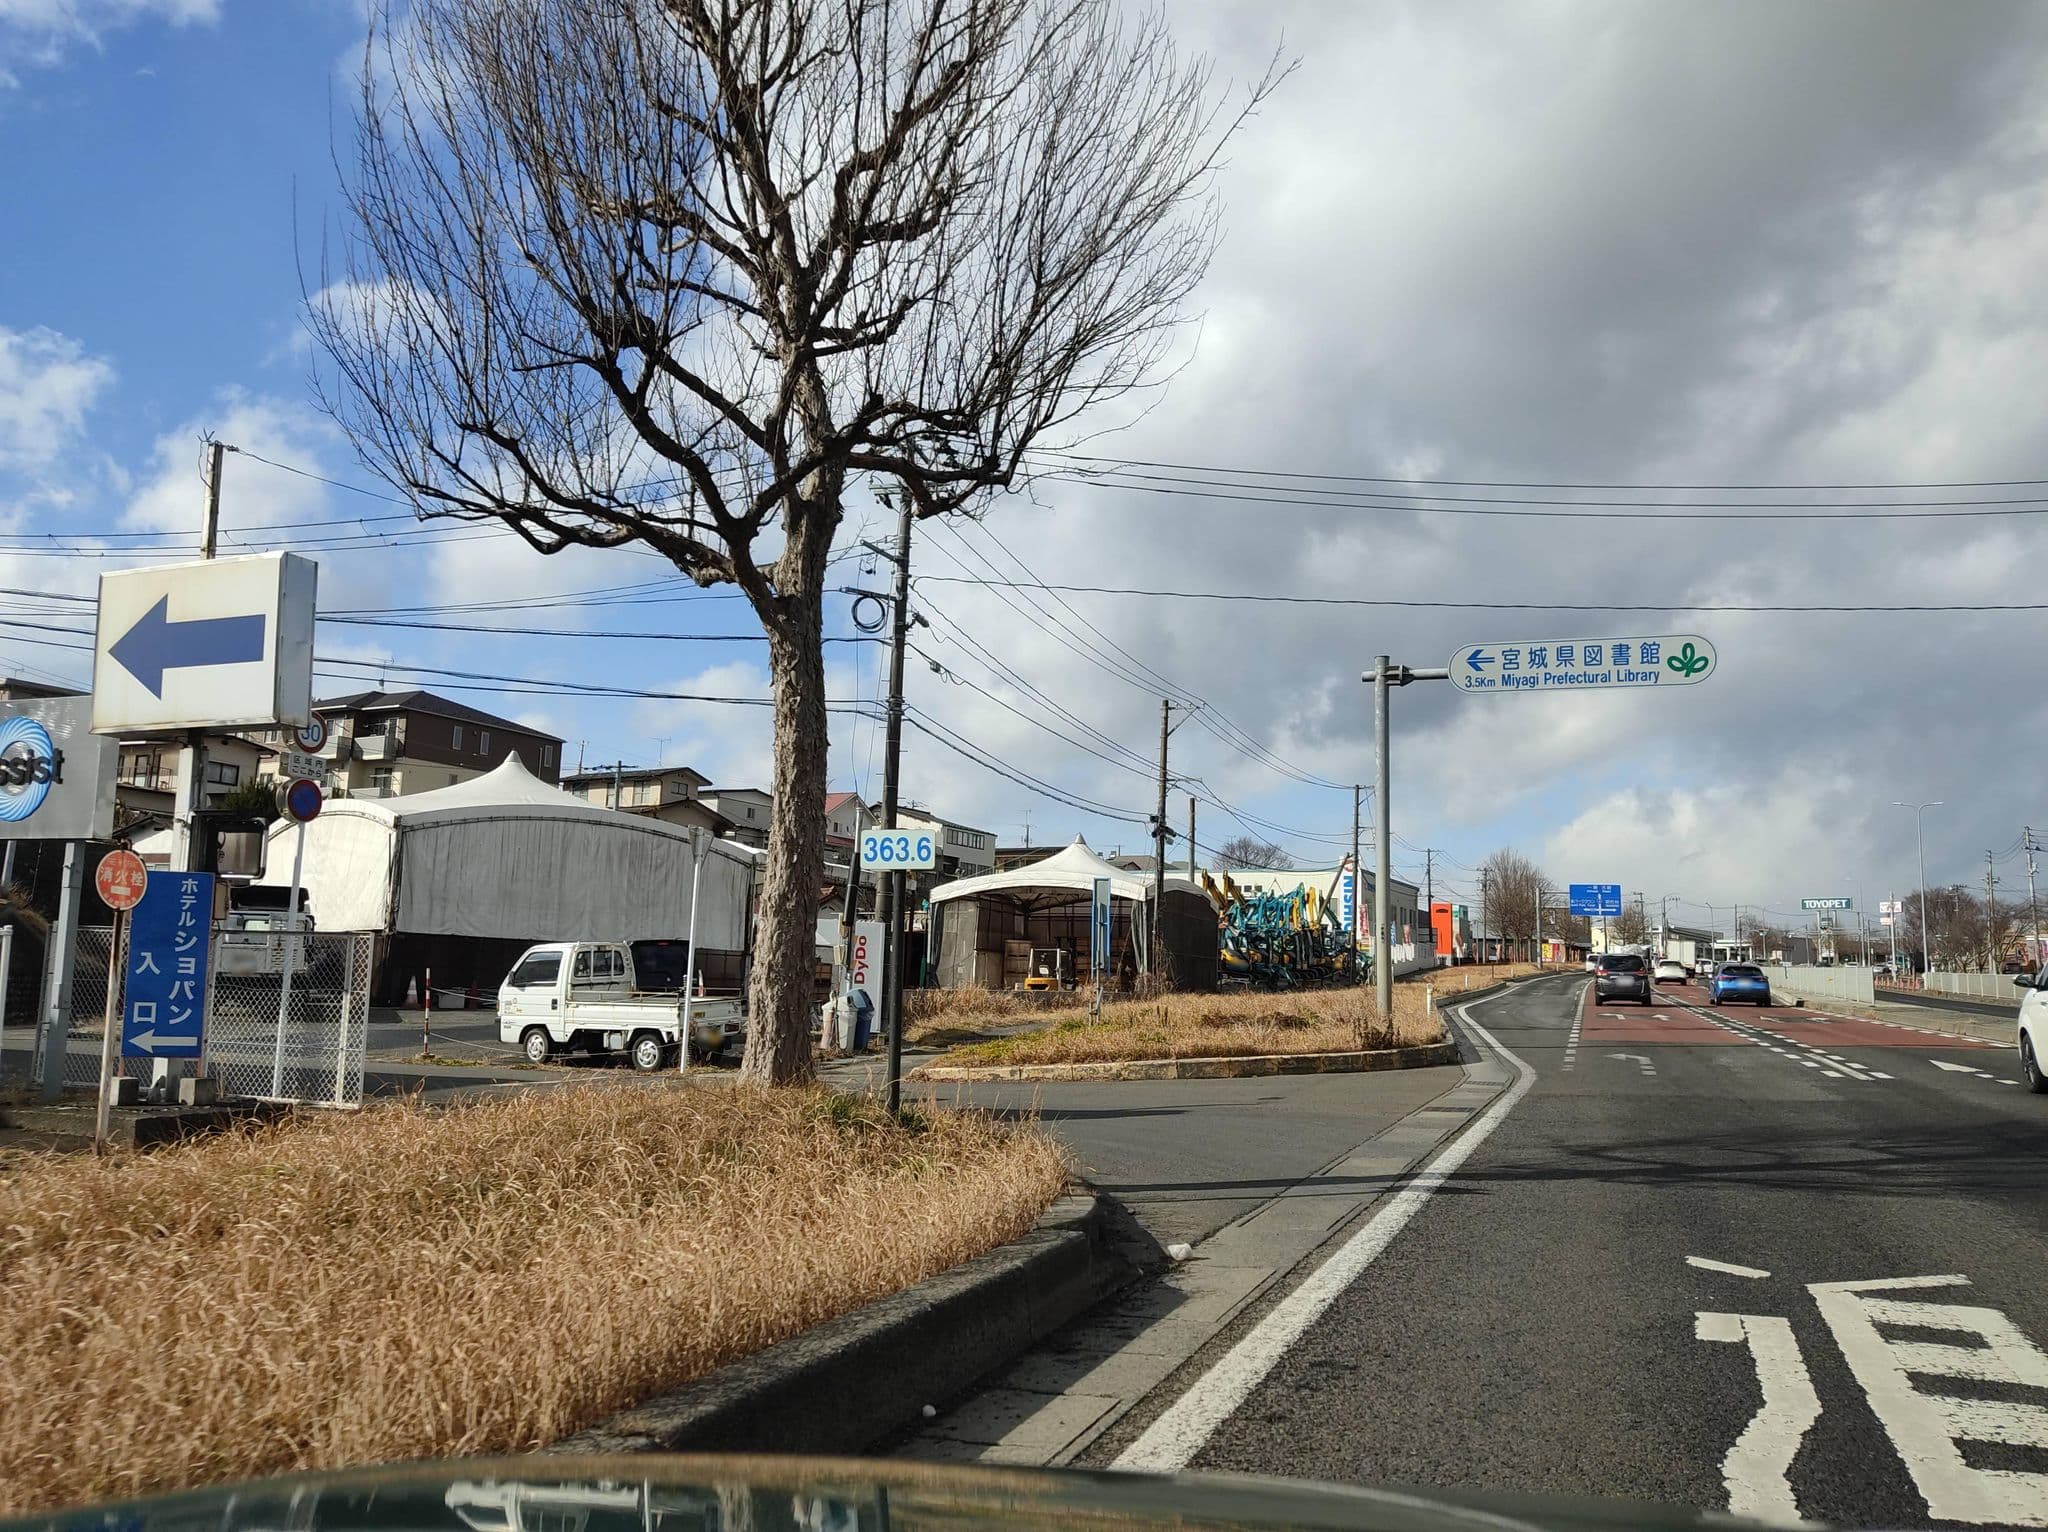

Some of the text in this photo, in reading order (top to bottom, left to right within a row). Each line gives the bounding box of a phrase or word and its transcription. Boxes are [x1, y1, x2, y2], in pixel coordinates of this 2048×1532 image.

[1501, 641, 1661, 670] 宮城県図書館
[1465, 668, 1661, 689] 3.5Km Miyagi Prefectural Library
[292, 765, 322, 778] ここから
[863, 836, 931, 862] 363.6
[99, 867, 144, 887] 消火栓
[1803, 899, 1848, 909] TOYOPET
[854, 935, 869, 985] DyDo
[132, 951, 161, 1024] 入口
